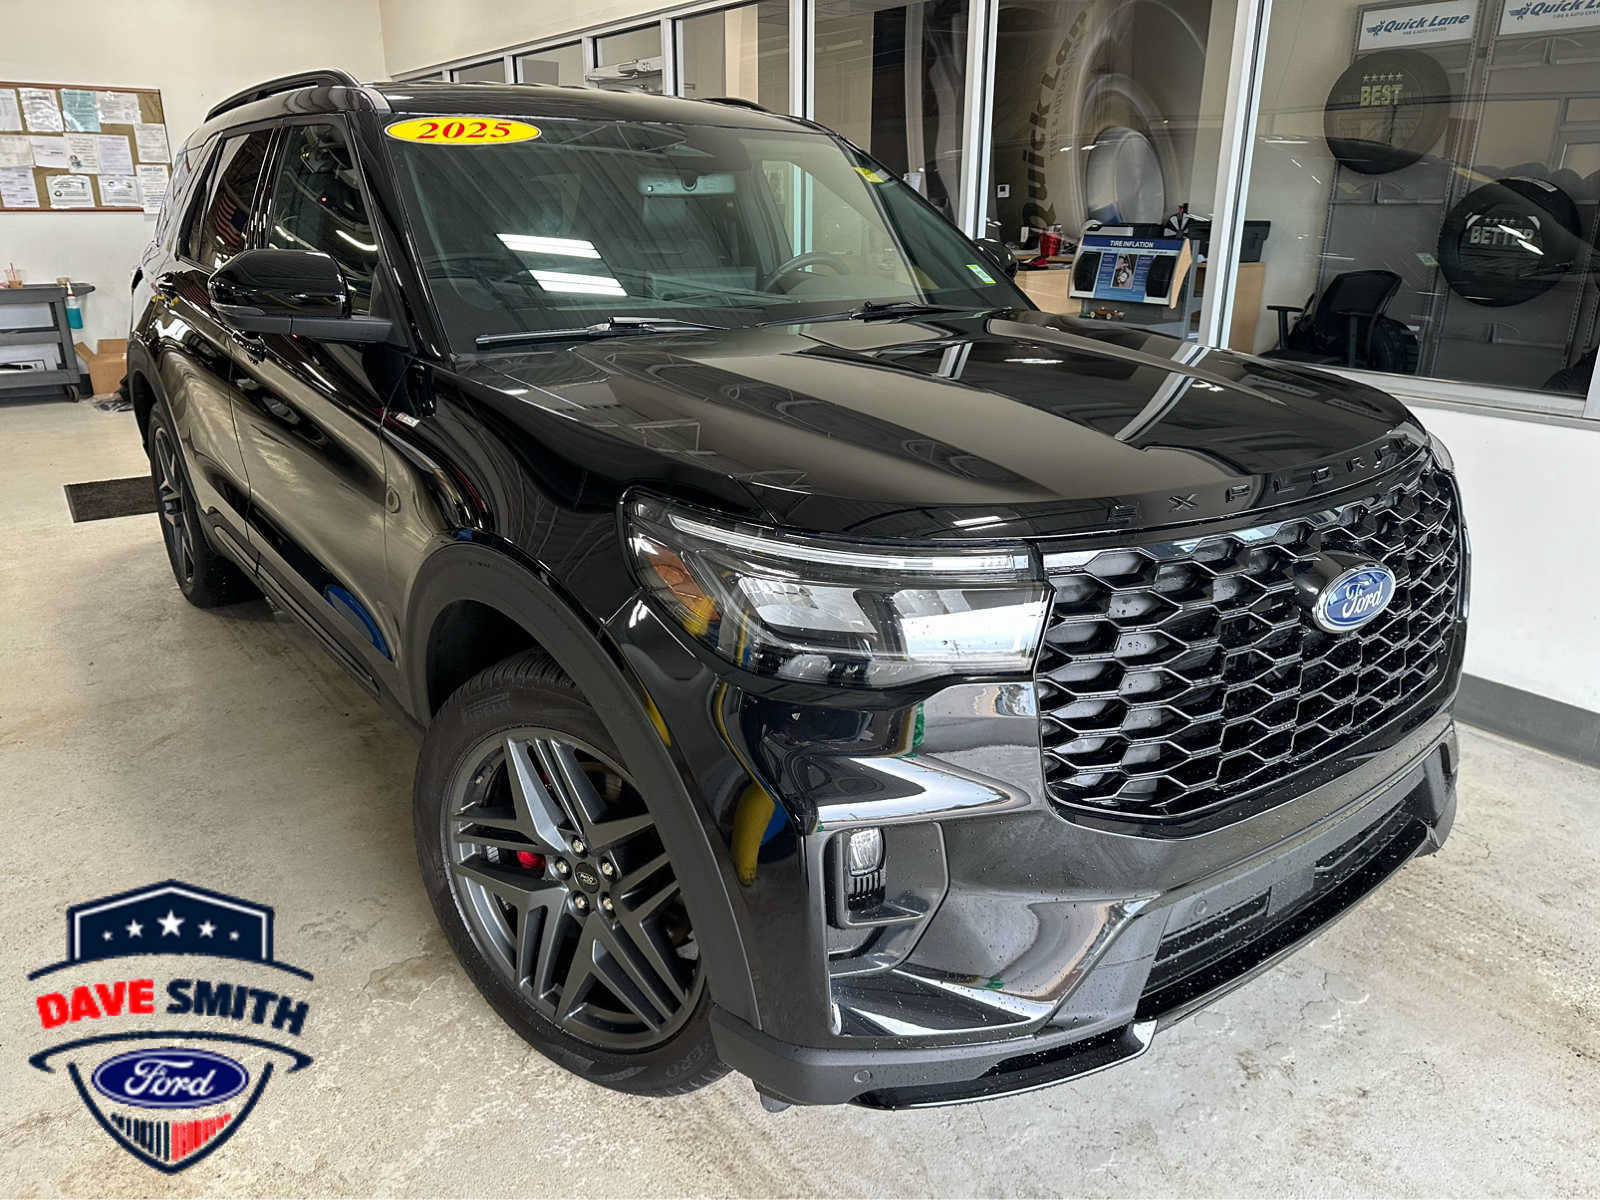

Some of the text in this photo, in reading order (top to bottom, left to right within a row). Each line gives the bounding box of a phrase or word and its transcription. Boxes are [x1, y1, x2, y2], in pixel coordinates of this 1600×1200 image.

[1530, 0, 1584, 16] Quick
[1383, 14, 1470, 32] Quick Lane
[1360, 84, 1402, 106] BEST
[416, 122, 512, 139] 2025
[1342, 578, 1384, 619] Ford
